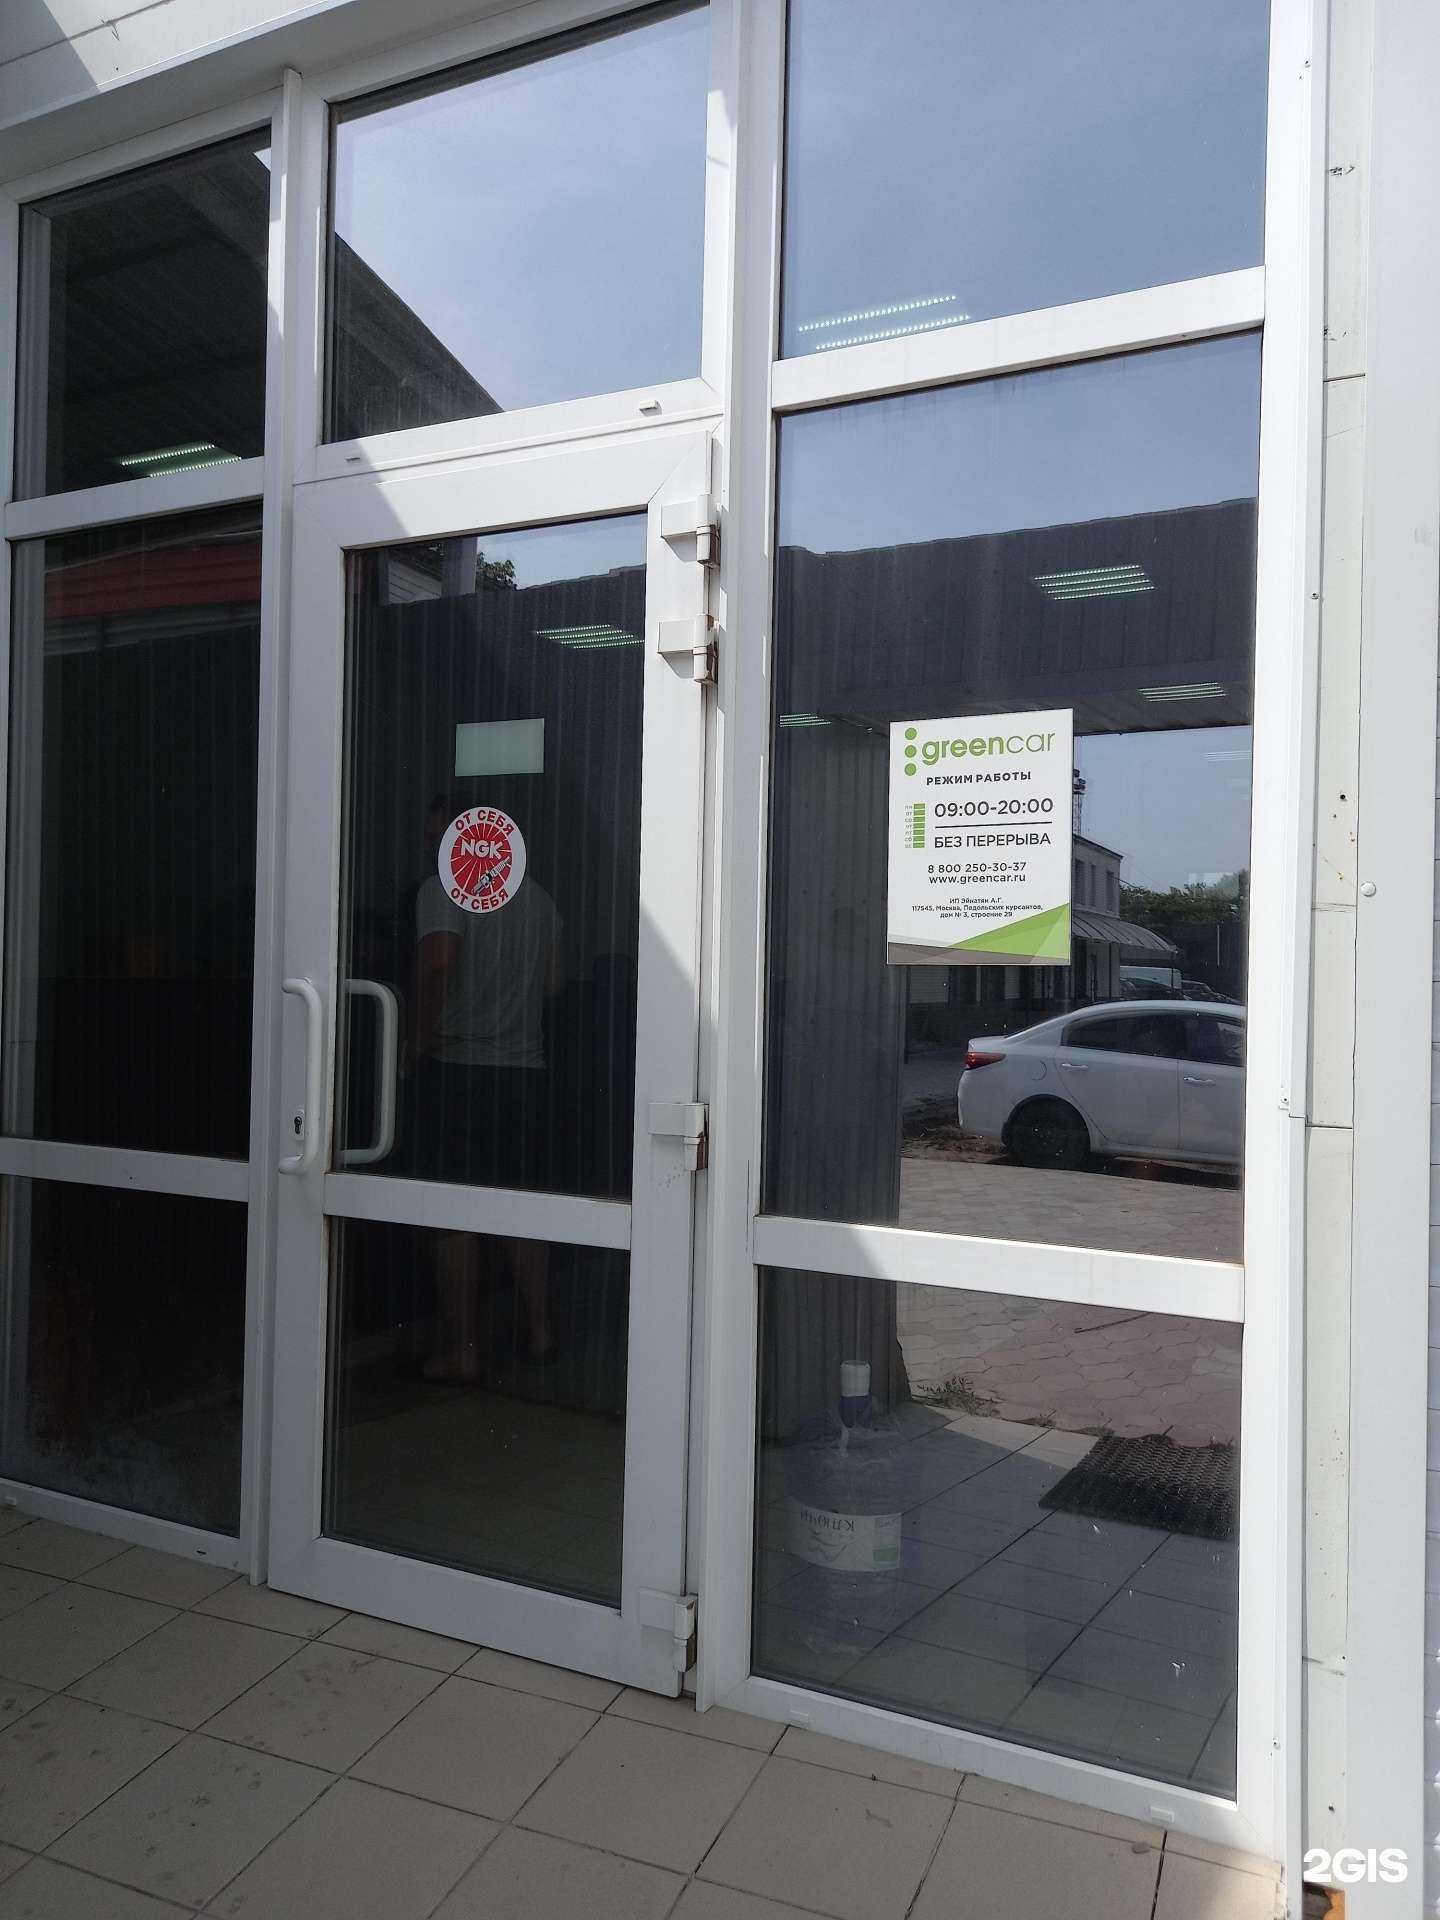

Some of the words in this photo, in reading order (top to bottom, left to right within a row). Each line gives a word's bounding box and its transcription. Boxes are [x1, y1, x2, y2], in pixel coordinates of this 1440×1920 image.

[921, 732, 1055, 766] greencar
[926, 774, 973, 786] РЕЖИМ
[975, 772, 1031, 783] РАБОТЫ
[934, 797, 1054, 818] 09:00-20:00
[455, 812, 471, 831] ОТ
[477, 809, 515, 836] СЕБЯ
[461, 838, 503, 860] NGK
[934, 835, 963, 849] БЕЗ
[966, 833, 1051, 848] ПЕРЕРЫВА
[927, 864, 934, 874] 8
[938, 863, 961, 874] 800
[965, 861, 1027, 873] 250-30-37
[928, 873, 1026, 885] www.greencar.ru
[451, 887, 468, 905] ОТ
[471, 888, 509, 911] СЕБЯ
[963, 904, 1004, 912] Подольских
